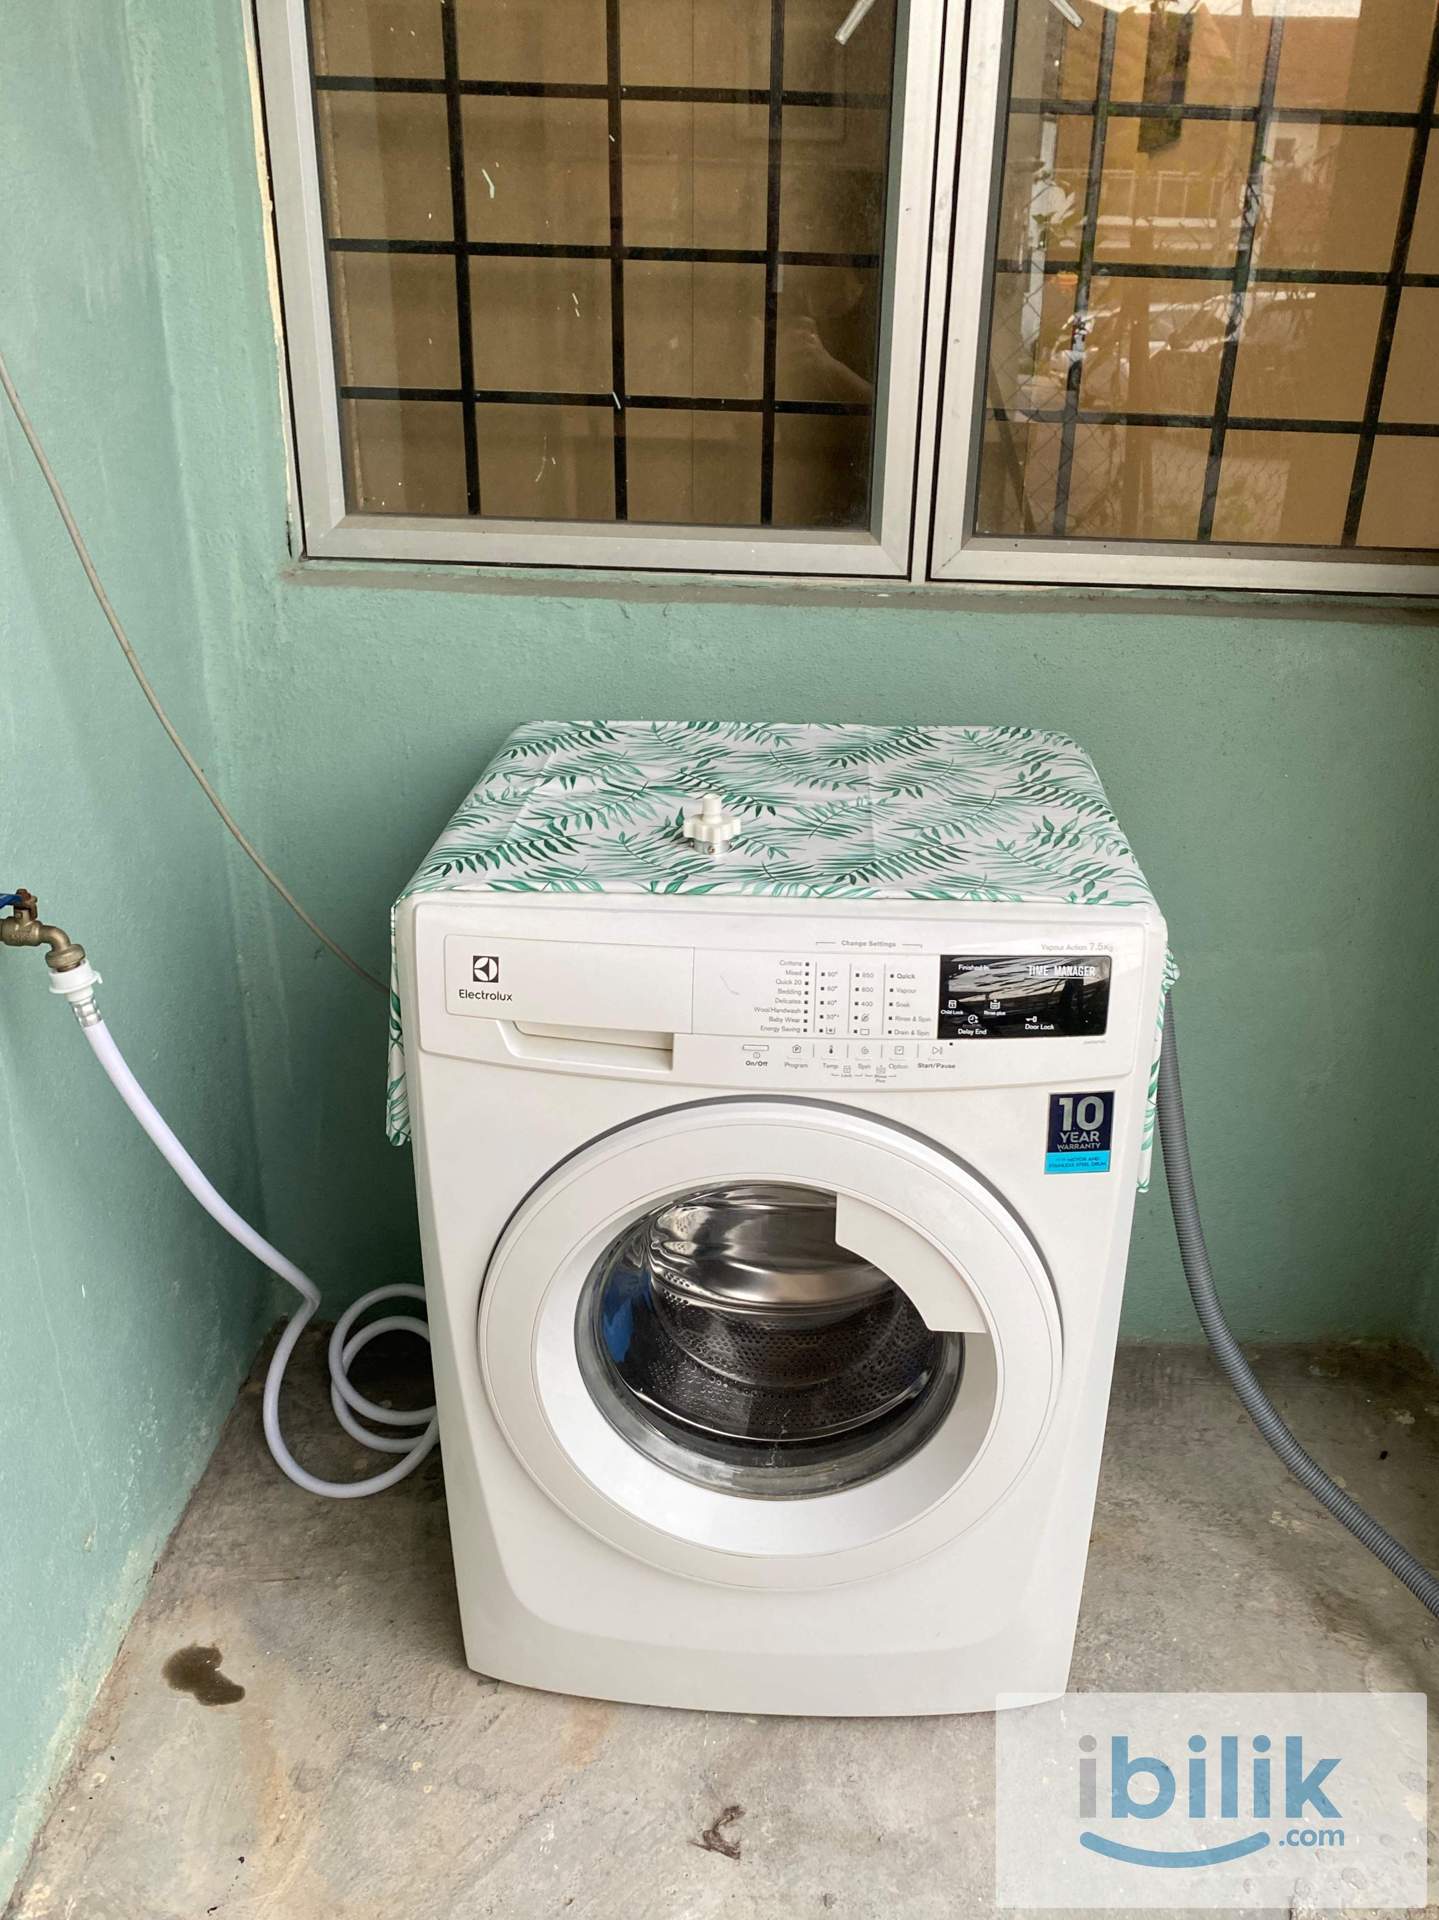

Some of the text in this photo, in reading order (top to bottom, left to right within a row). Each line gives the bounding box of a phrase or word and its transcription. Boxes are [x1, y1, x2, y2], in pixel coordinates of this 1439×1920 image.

[841, 940, 897, 948] Change Settings
[1066, 943, 1088, 951] Action
[1028, 965, 1096, 977] TIME MANAGER
[896, 972, 916, 980] Quick
[458, 989, 513, 1002] Electrolux
[777, 987, 802, 996] Bedding
[760, 1025, 801, 1033] Energy Saving
[916, 1029, 930, 1037] Spin
[957, 1028, 988, 1036] Delay End
[1059, 1095, 1104, 1131] 10
[1060, 1131, 1100, 1143] YEAR
[1057, 1142, 1101, 1151] WARRANTY
